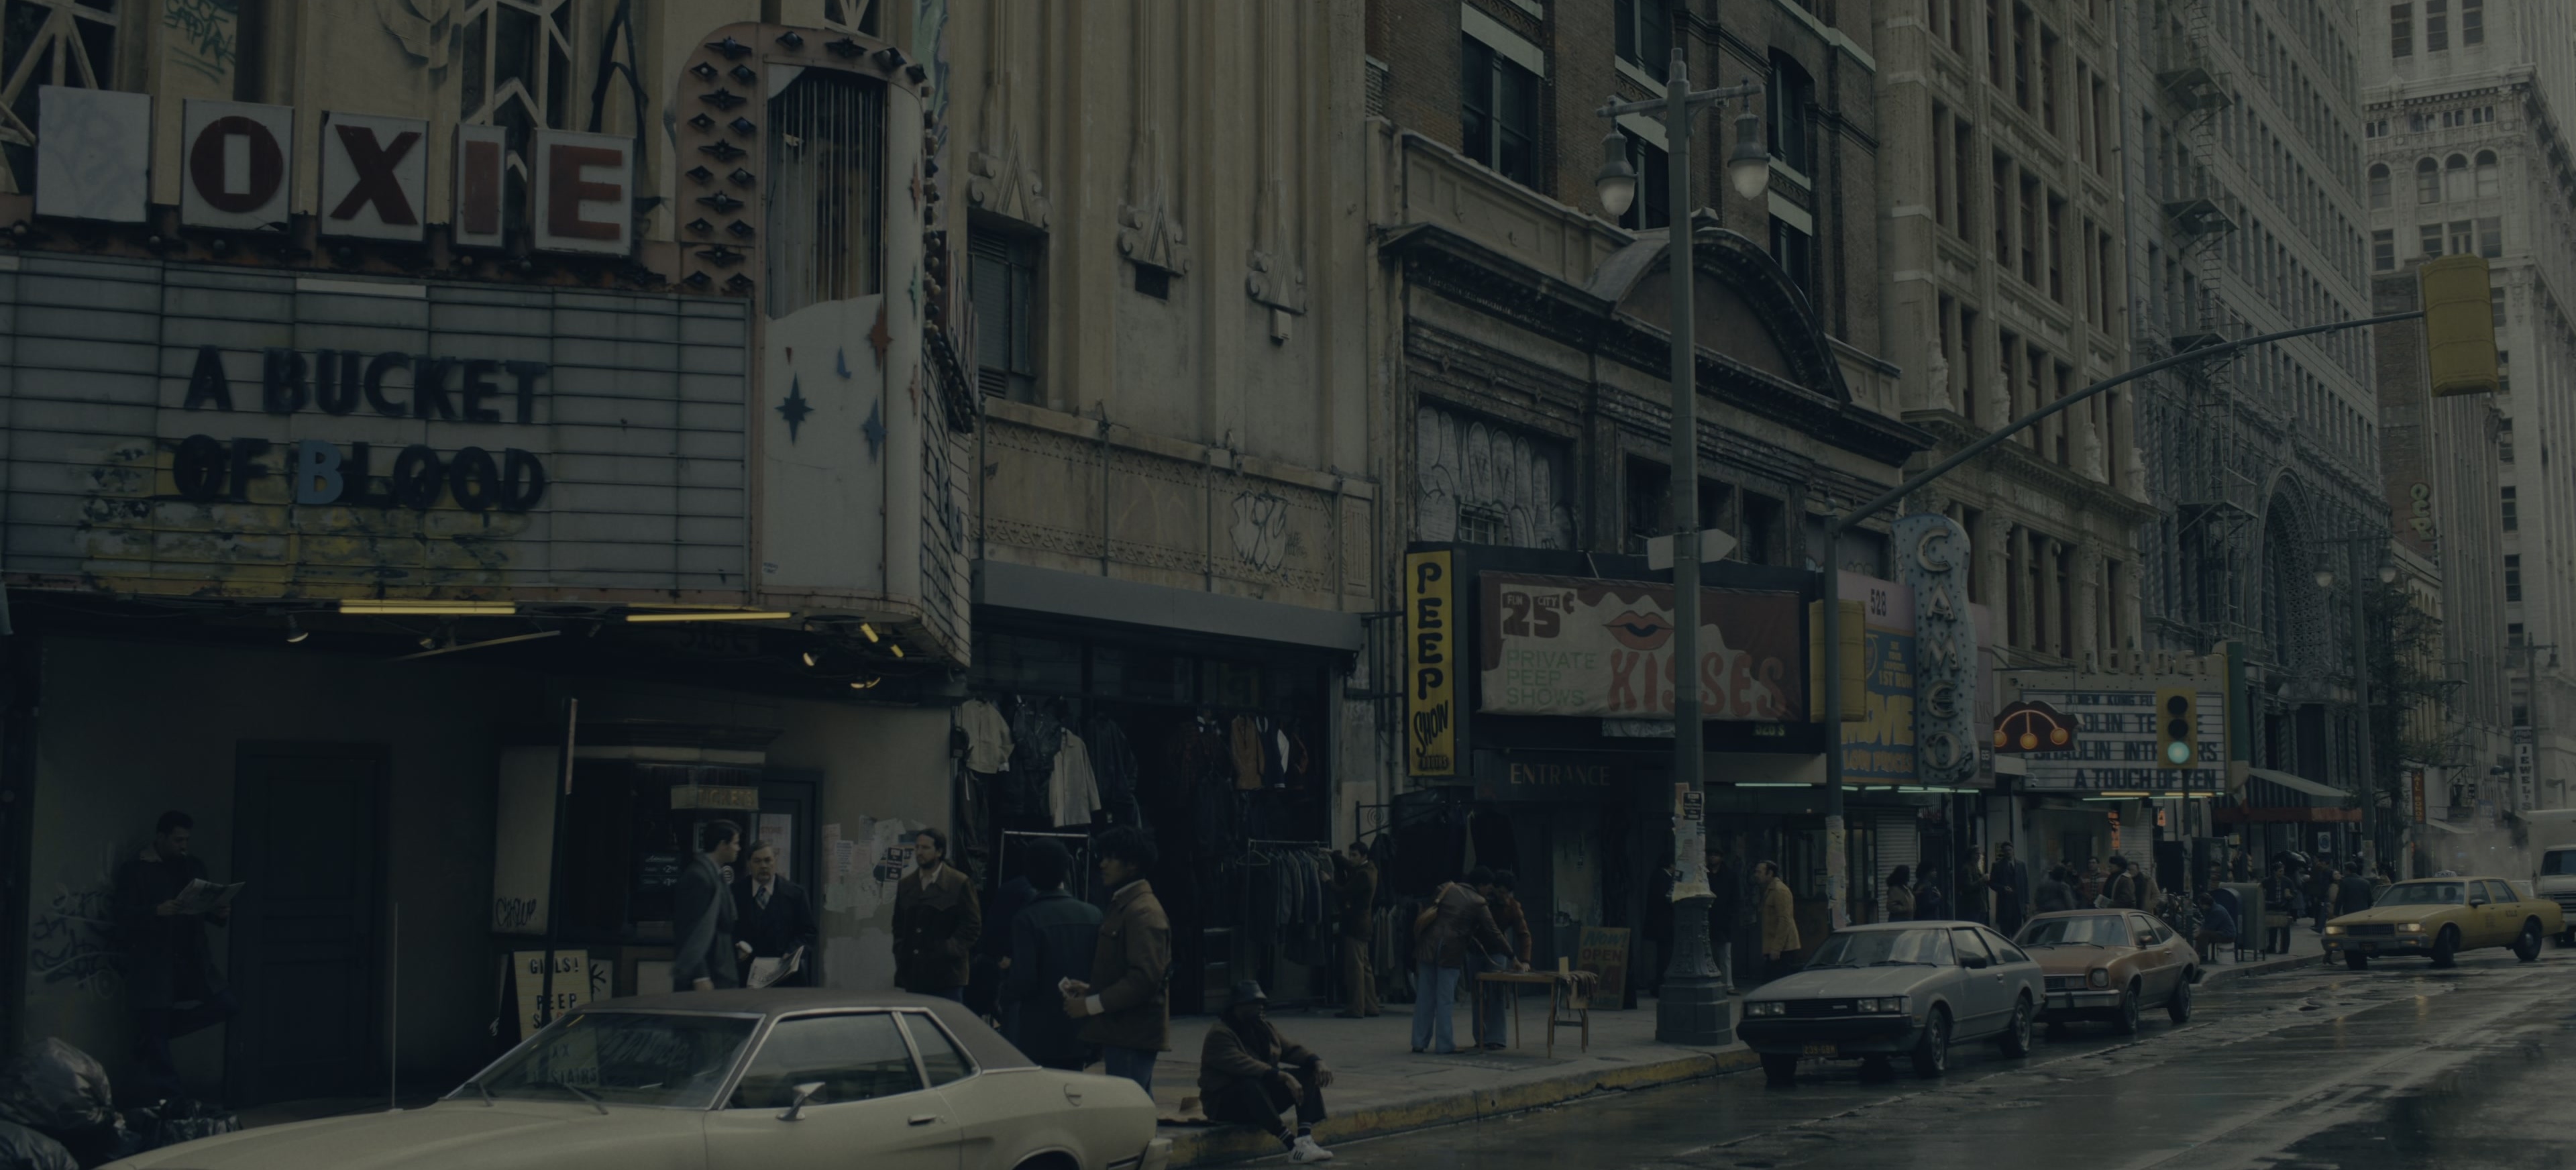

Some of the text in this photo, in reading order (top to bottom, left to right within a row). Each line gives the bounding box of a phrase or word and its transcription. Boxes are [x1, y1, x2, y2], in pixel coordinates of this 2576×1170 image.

[190, 115, 623, 240] OXIE
[183, 344, 547, 425] A BUCKET
[173, 433, 545, 513] OF BLOOD
[1507, 595, 1558, 607] FUN CITY
[1870, 588, 1886, 616] 528
[1417, 562, 1442, 700] PEEP
[1916, 526, 1962, 769] CAMEO
[1507, 649, 1597, 670] PRIVATE
[1507, 669, 1562, 686] PEEP
[1607, 649, 1786, 718] KISSES
[1507, 688, 1585, 706] SHOWS
[1413, 700, 1448, 757] SHOW
[1510, 763, 1611, 786] ENTRANCE
[2075, 769, 2087, 788] A
[2092, 769, 2151, 789] TOUCH
[2157, 769, 2178, 789] OF
[698, 789, 754, 804] TICKETS
[530, 957, 578, 974] GILS!
[1582, 949, 1621, 962] OPEN
